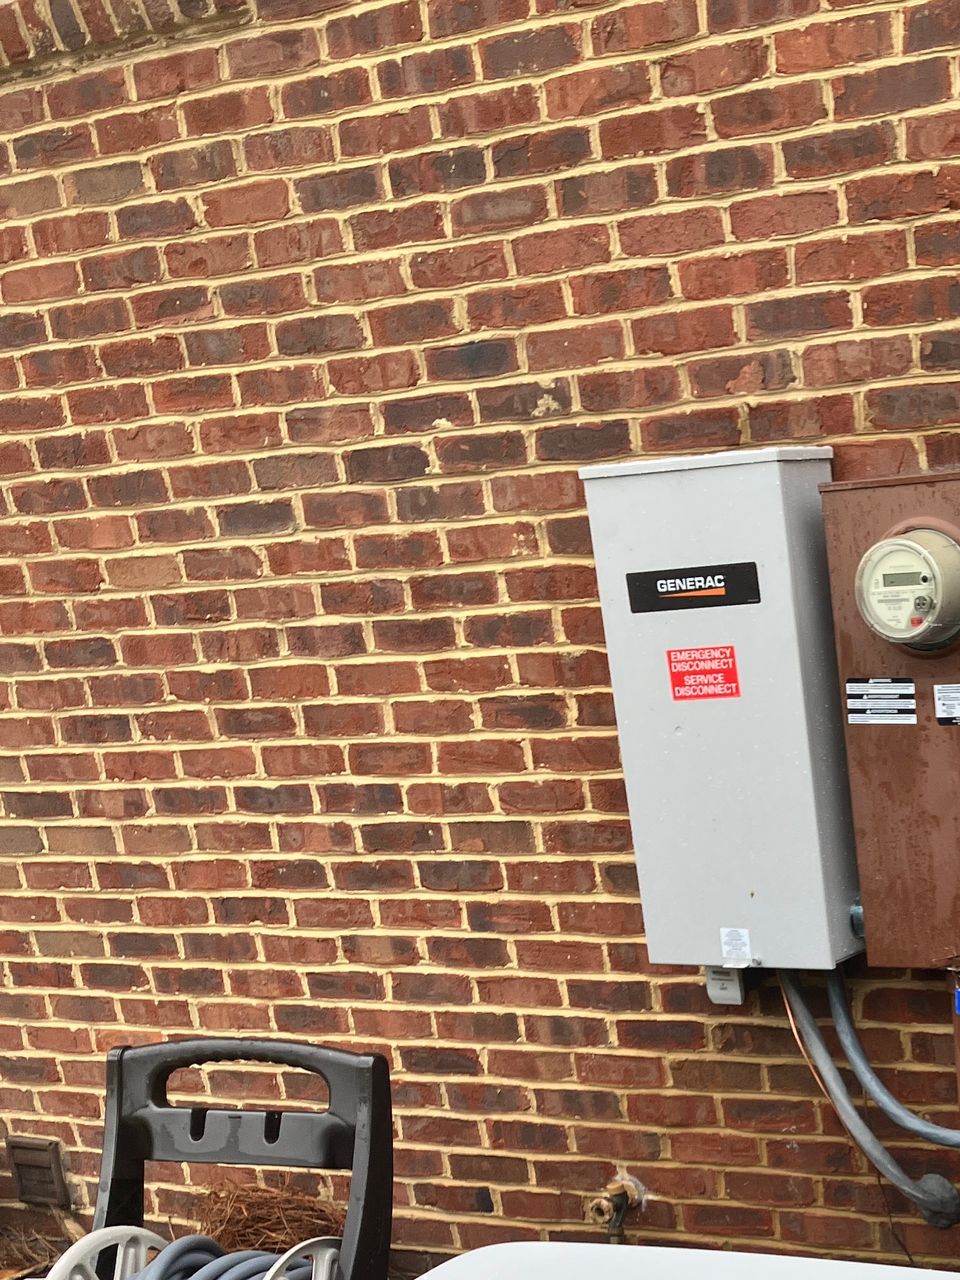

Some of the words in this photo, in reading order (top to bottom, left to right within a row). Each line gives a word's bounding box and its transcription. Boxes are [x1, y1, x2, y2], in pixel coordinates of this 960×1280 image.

[656, 574, 725, 592] GENERAC
[670, 648, 731, 661] EMERGENCY
[671, 658, 733, 672] DISCONNECT
[683, 673, 725, 685] SERVICE
[674, 683, 737, 696] DISCONNECT
